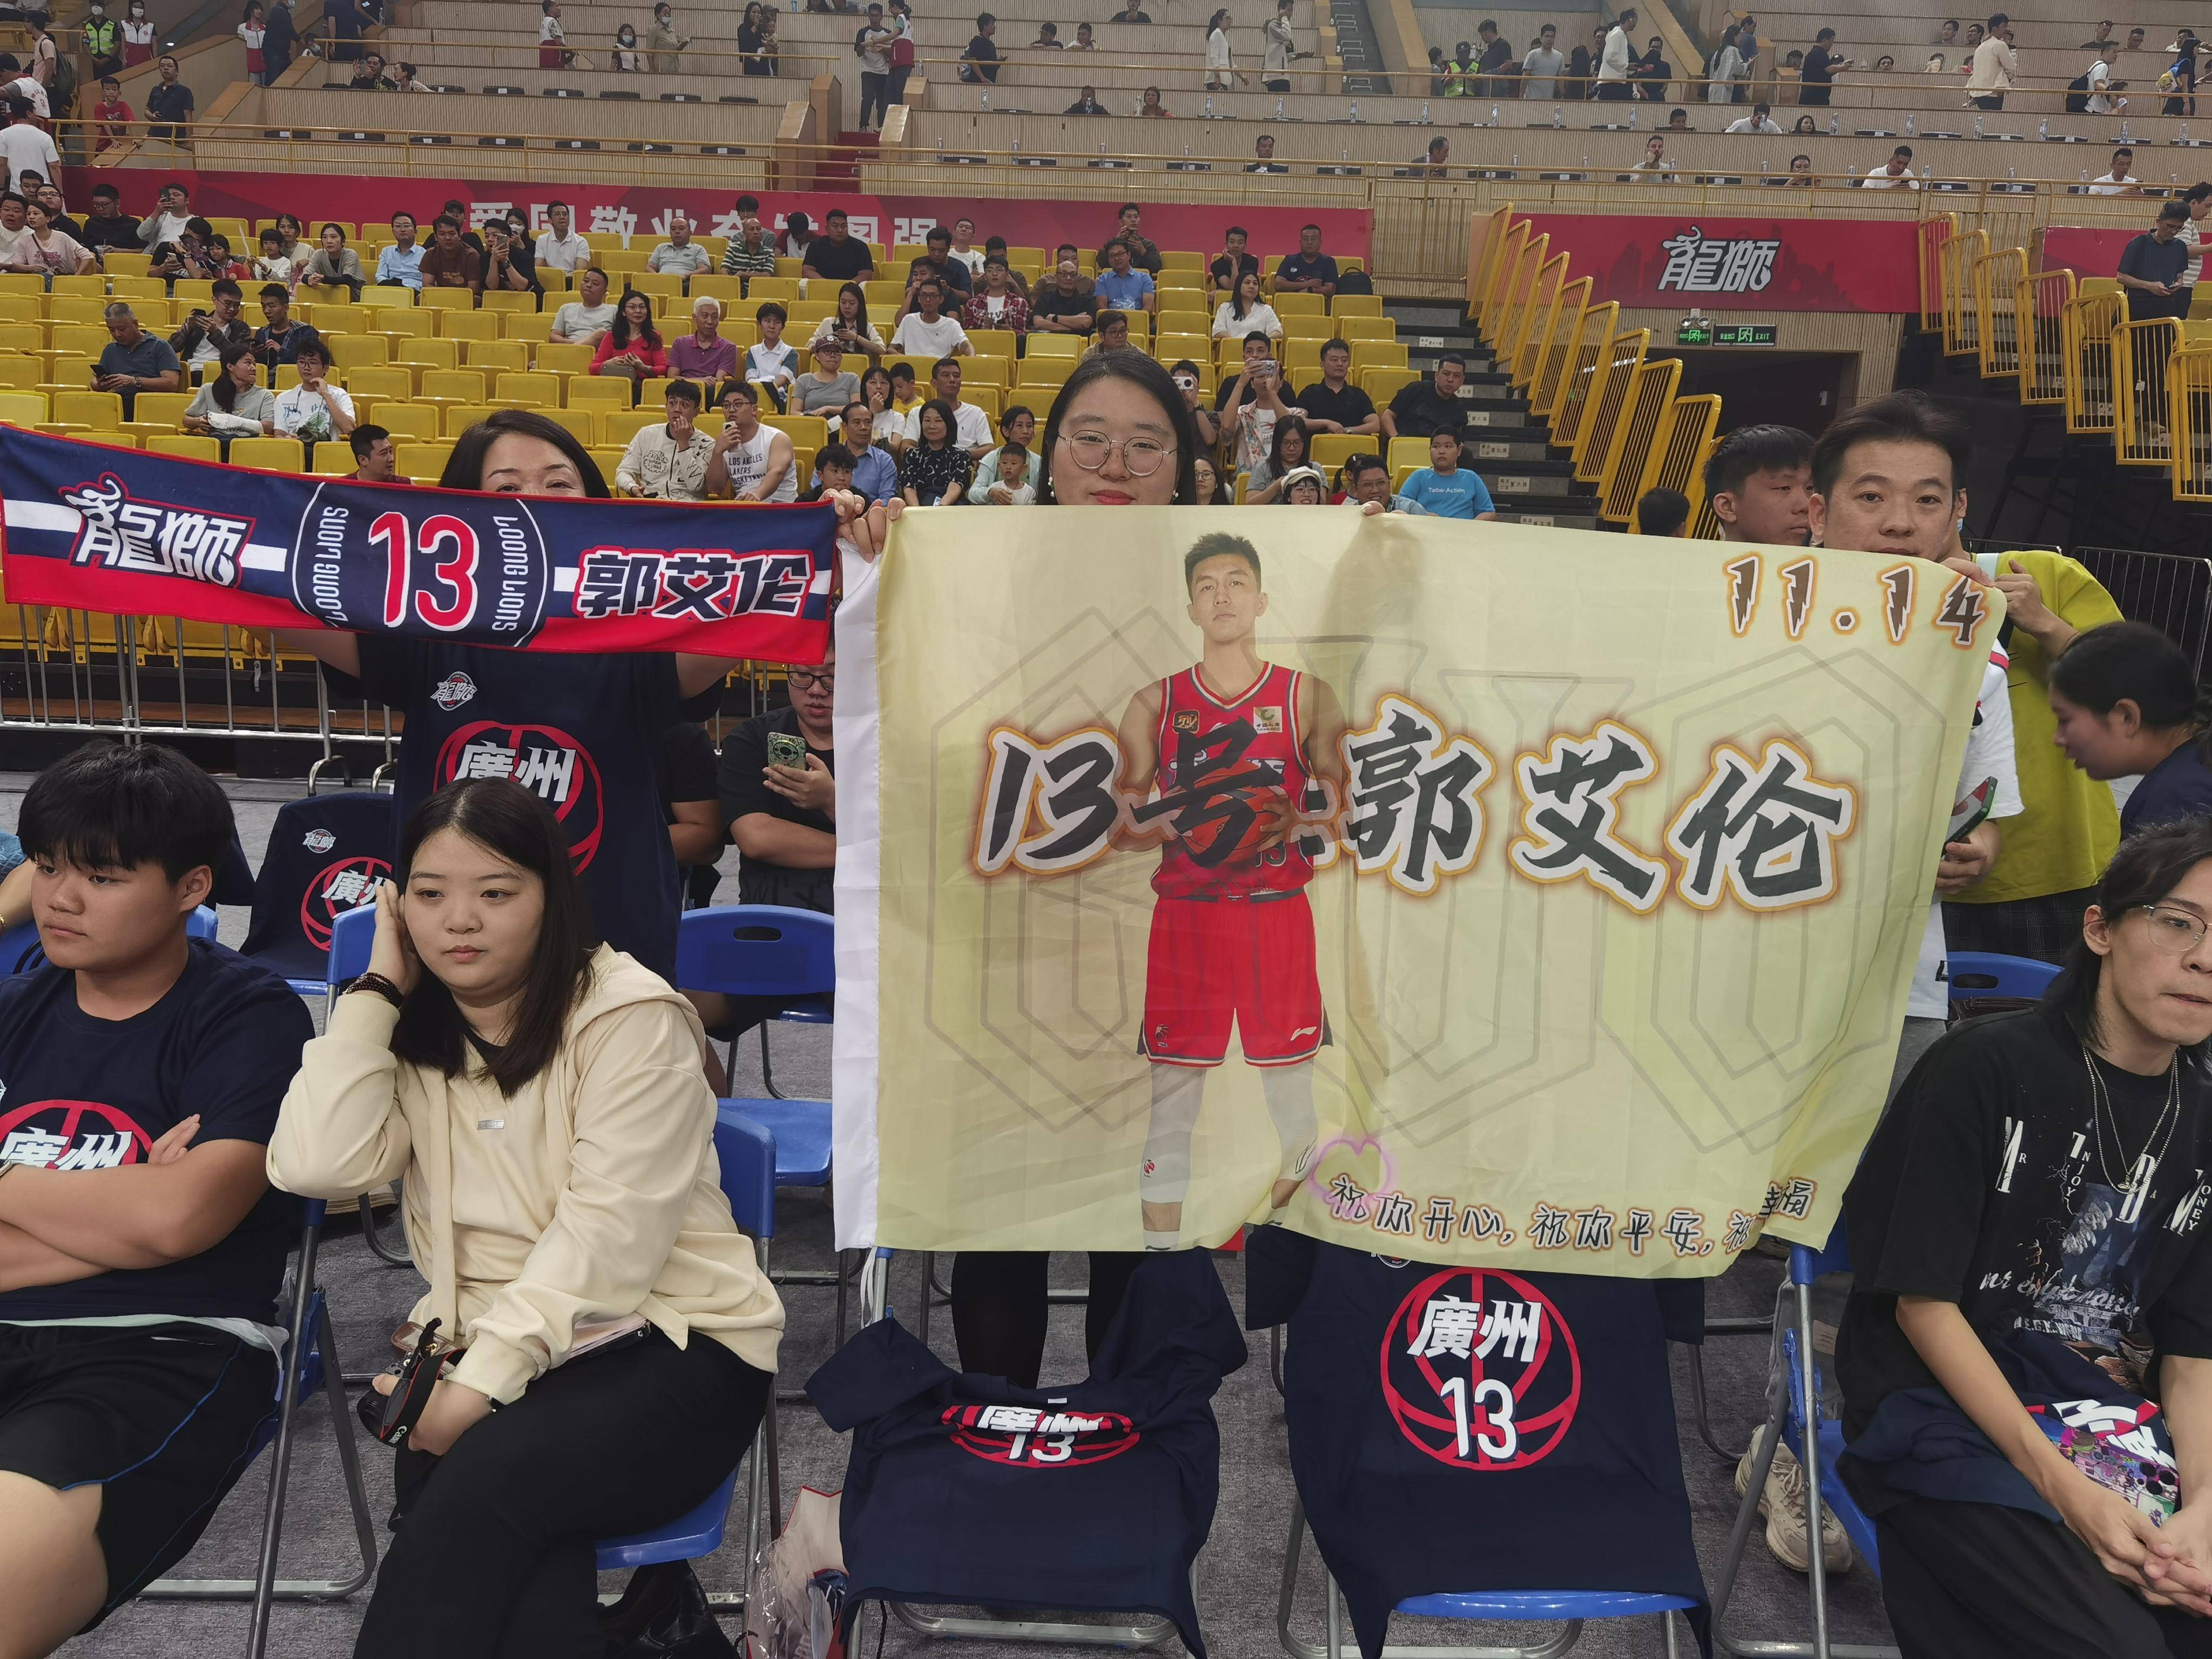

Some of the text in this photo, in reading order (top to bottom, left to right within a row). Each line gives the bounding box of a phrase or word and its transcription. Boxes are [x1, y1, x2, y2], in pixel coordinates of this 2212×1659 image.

[729, 457, 741, 466] LOS
[729, 466, 751, 476] LAKERS
[64, 478, 248, 586] 龍獅
[312, 506, 349, 622] LOONG LIONS
[368, 511, 480, 632] 13
[491, 515, 529, 632] LOONG LIONS
[577, 549, 810, 622] 郭艾伦
[1727, 556, 1985, 646] 11.14
[1406, 1294, 1542, 1363] 廣州
[1008, 1431, 1076, 1462] 13
[1440, 1377, 1519, 1459] 13
